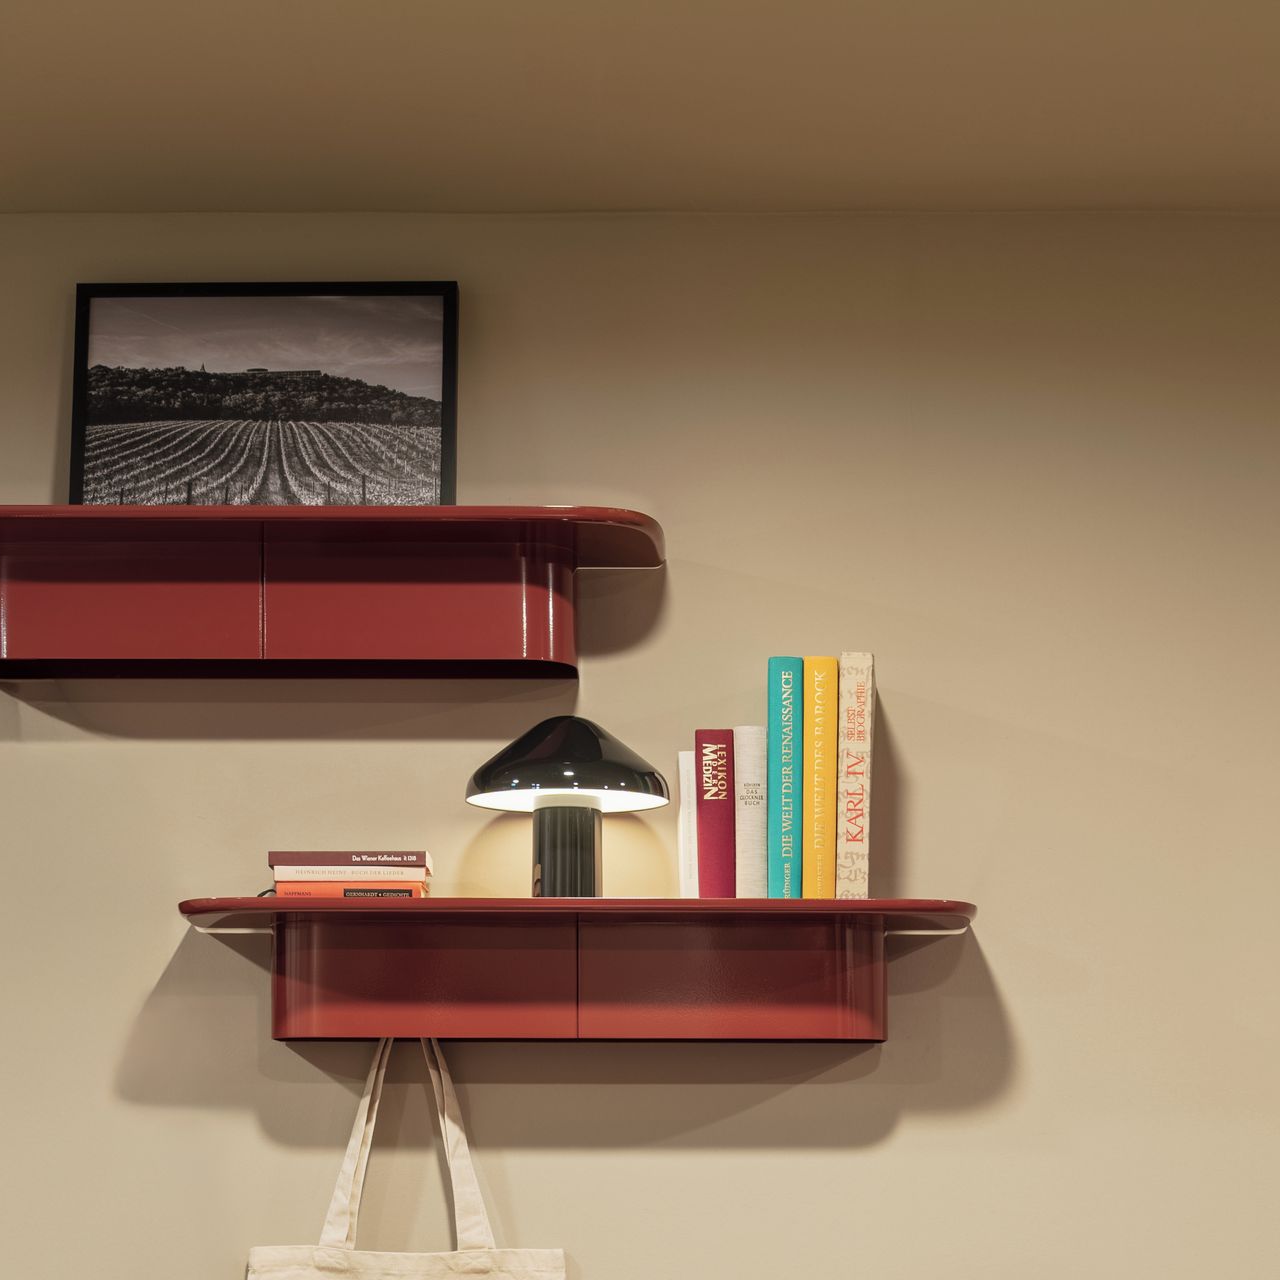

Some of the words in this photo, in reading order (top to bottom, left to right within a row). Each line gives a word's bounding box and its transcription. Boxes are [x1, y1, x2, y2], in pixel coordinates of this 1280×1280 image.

[781, 670, 793, 765] RENAISSANCE
[814, 670, 826, 736] BAROCK
[847, 707, 856, 741] SELBST
[856, 681, 866, 742] BIOGRAPHIE
[702, 742, 719, 801] MEDIZIN
[716, 743, 728, 800] LEXIKON
[814, 741, 826, 771] DES
[781, 766, 793, 794] DER
[814, 774, 826, 819] WELT
[781, 795, 793, 832] WELT
[814, 823, 826, 849] DIE
[845, 783, 864, 844] KARL
[781, 834, 793, 858] DIE
